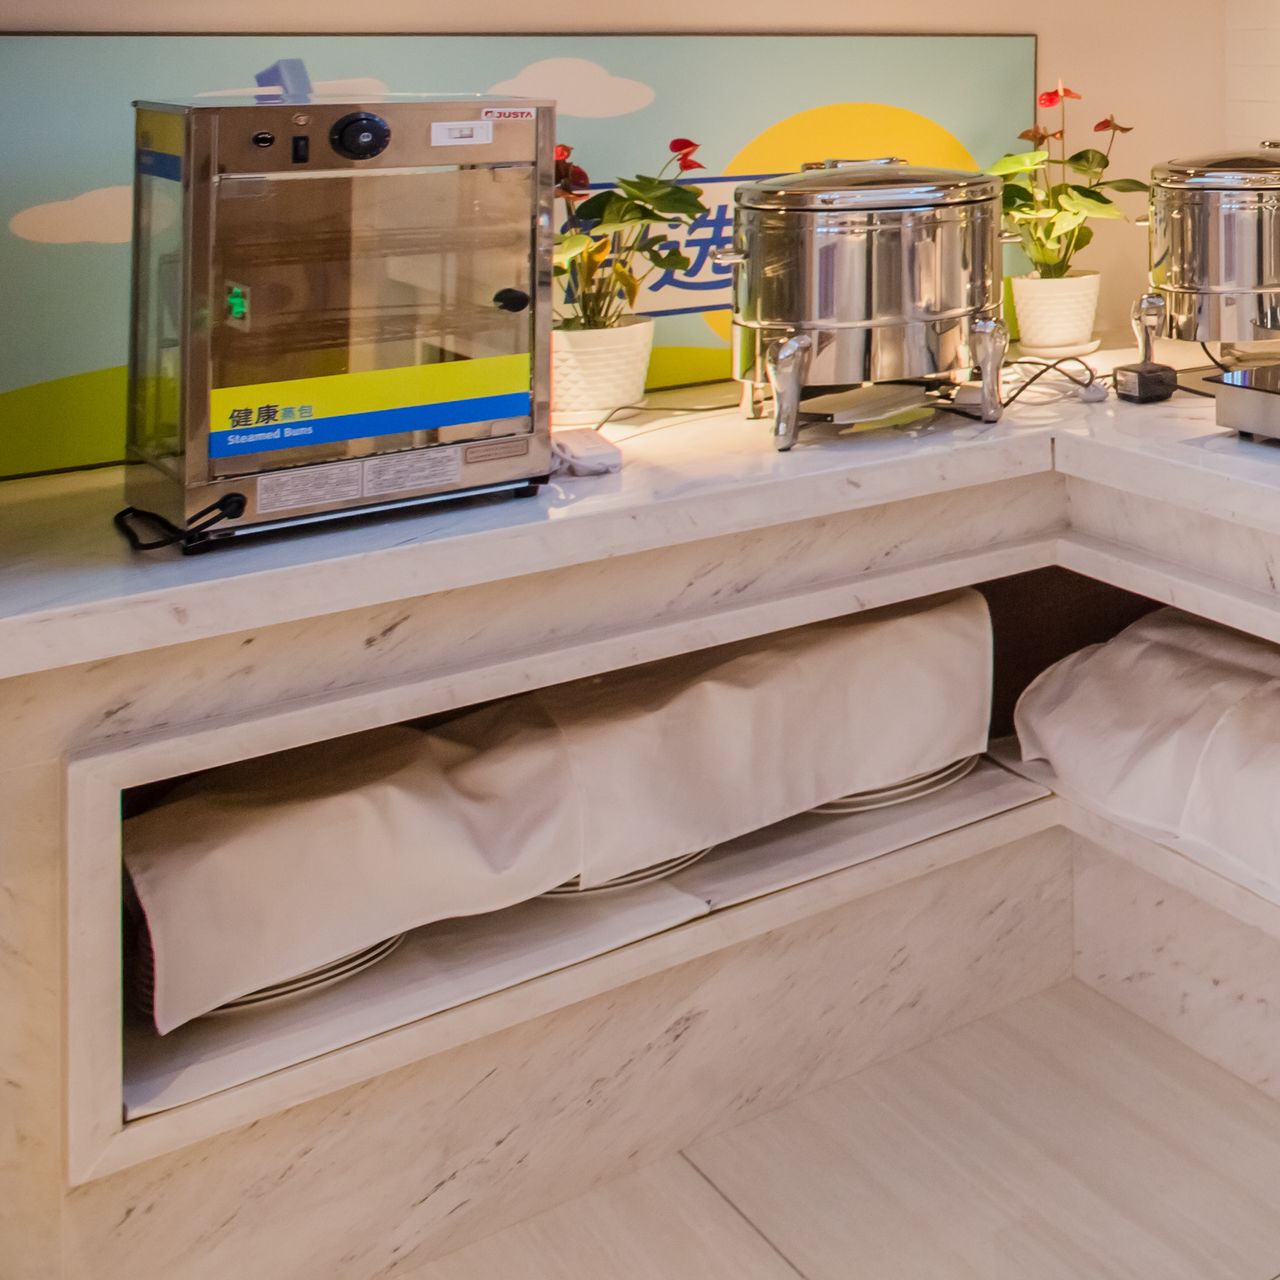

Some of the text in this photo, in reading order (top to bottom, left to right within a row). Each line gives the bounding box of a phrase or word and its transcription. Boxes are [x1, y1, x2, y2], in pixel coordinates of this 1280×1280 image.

[495, 111, 533, 119] JUSTA
[227, 426, 313, 445] Steamed Buns
